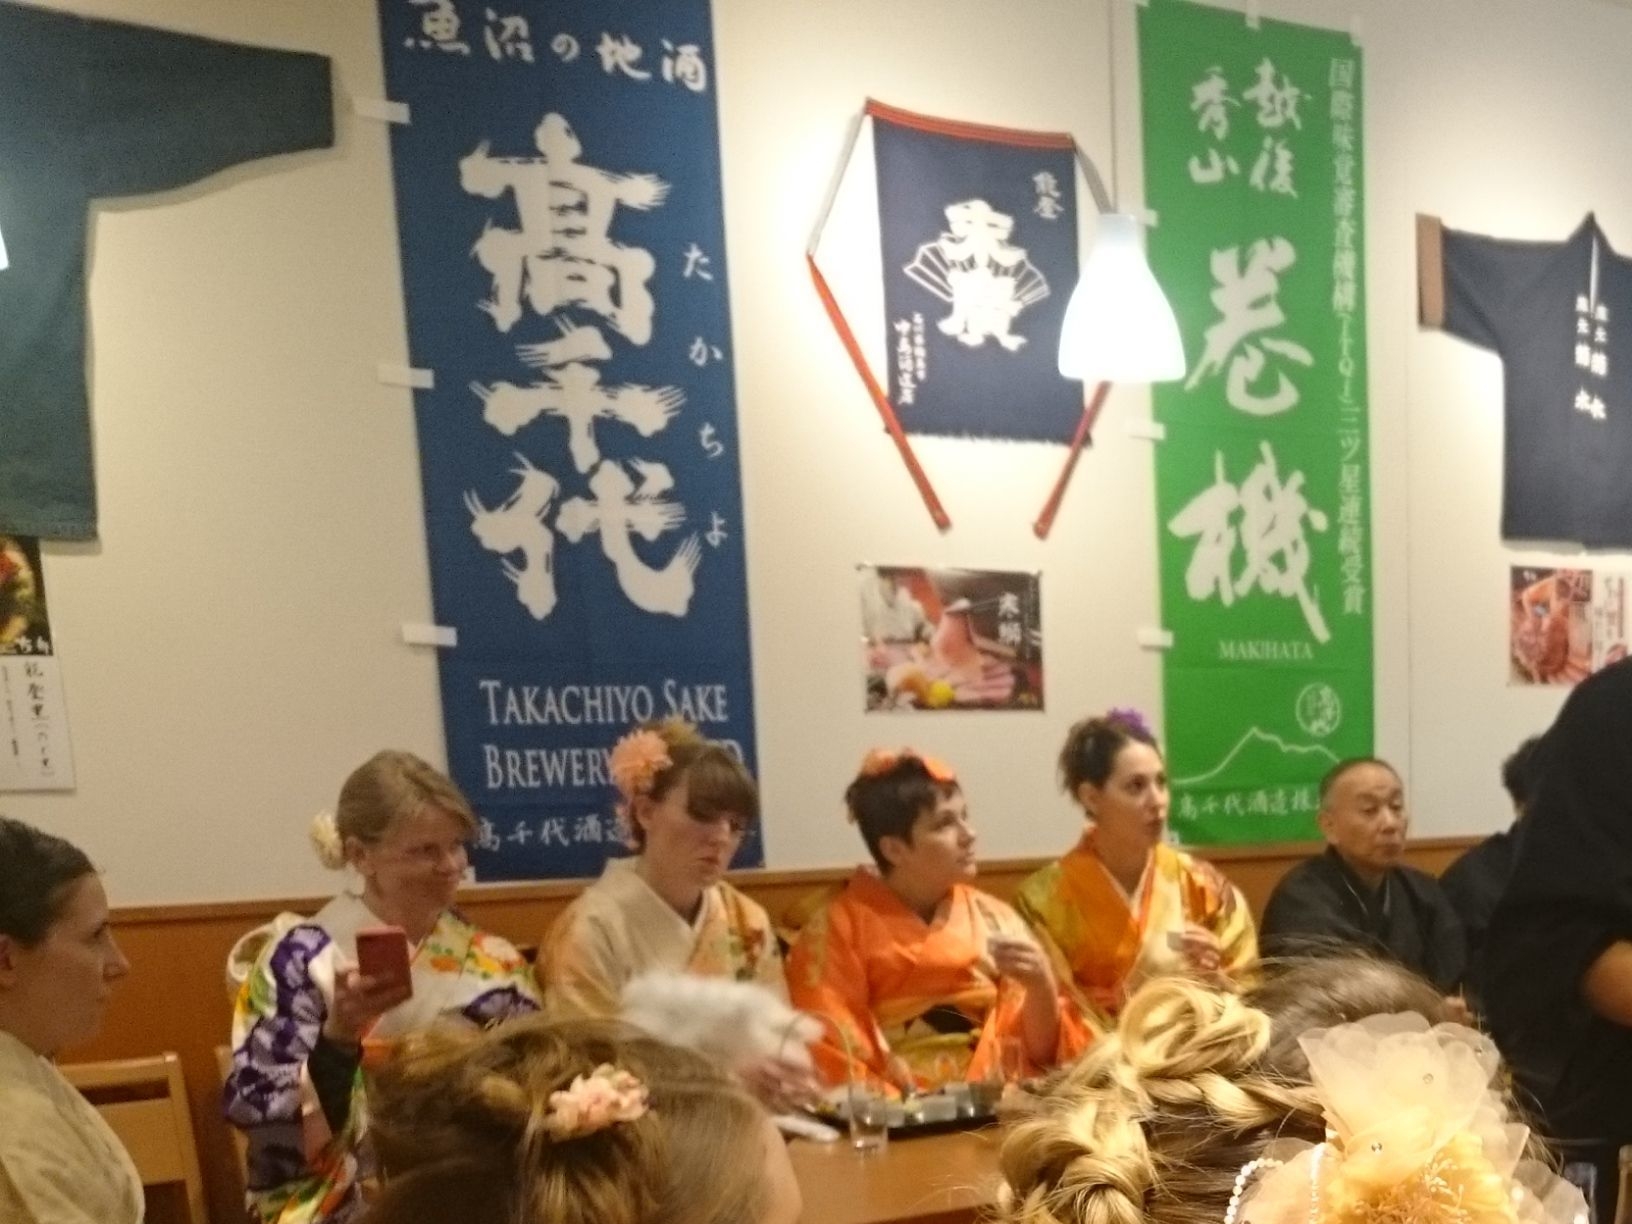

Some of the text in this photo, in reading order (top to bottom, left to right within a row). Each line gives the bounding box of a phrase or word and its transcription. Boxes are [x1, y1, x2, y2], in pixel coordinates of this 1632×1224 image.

[403, 0, 707, 92] 魚沼の地酒
[683, 242, 728, 547] たかちよ
[1219, 640, 1314, 659] MAKIHATA
[479, 678, 729, 725] TAKACHIYO SAKE
